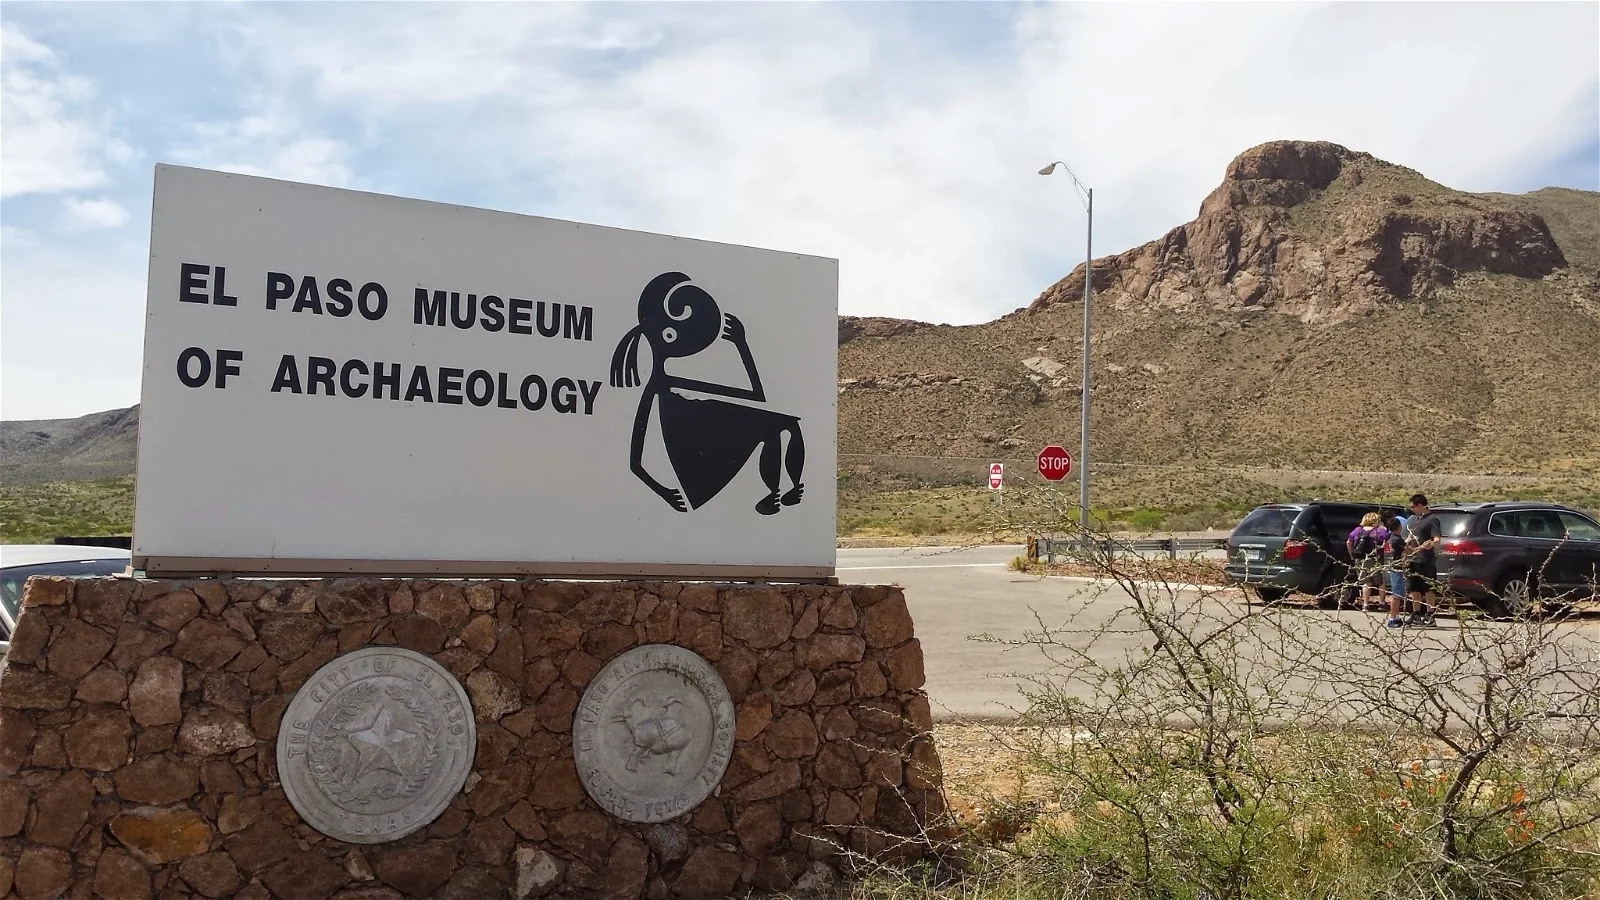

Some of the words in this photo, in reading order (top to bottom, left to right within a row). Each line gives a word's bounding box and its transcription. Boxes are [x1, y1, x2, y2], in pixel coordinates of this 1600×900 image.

[179, 263, 238, 306] EL
[266, 271, 388, 320] PASO
[413, 288, 593, 341] MUSEUM
[176, 346, 243, 389] OF
[271, 354, 602, 415] ARCHAEOLOGY
[1040, 457, 1069, 470] STOP
[287, 719, 310, 759] THE
[310, 666, 351, 703] CITY
[373, 659, 397, 673] OF
[415, 667, 435, 690] EL
[439, 691, 466, 736] PASO
[582, 683, 609, 723] PASO
[338, 810, 412, 833] TEXAS
